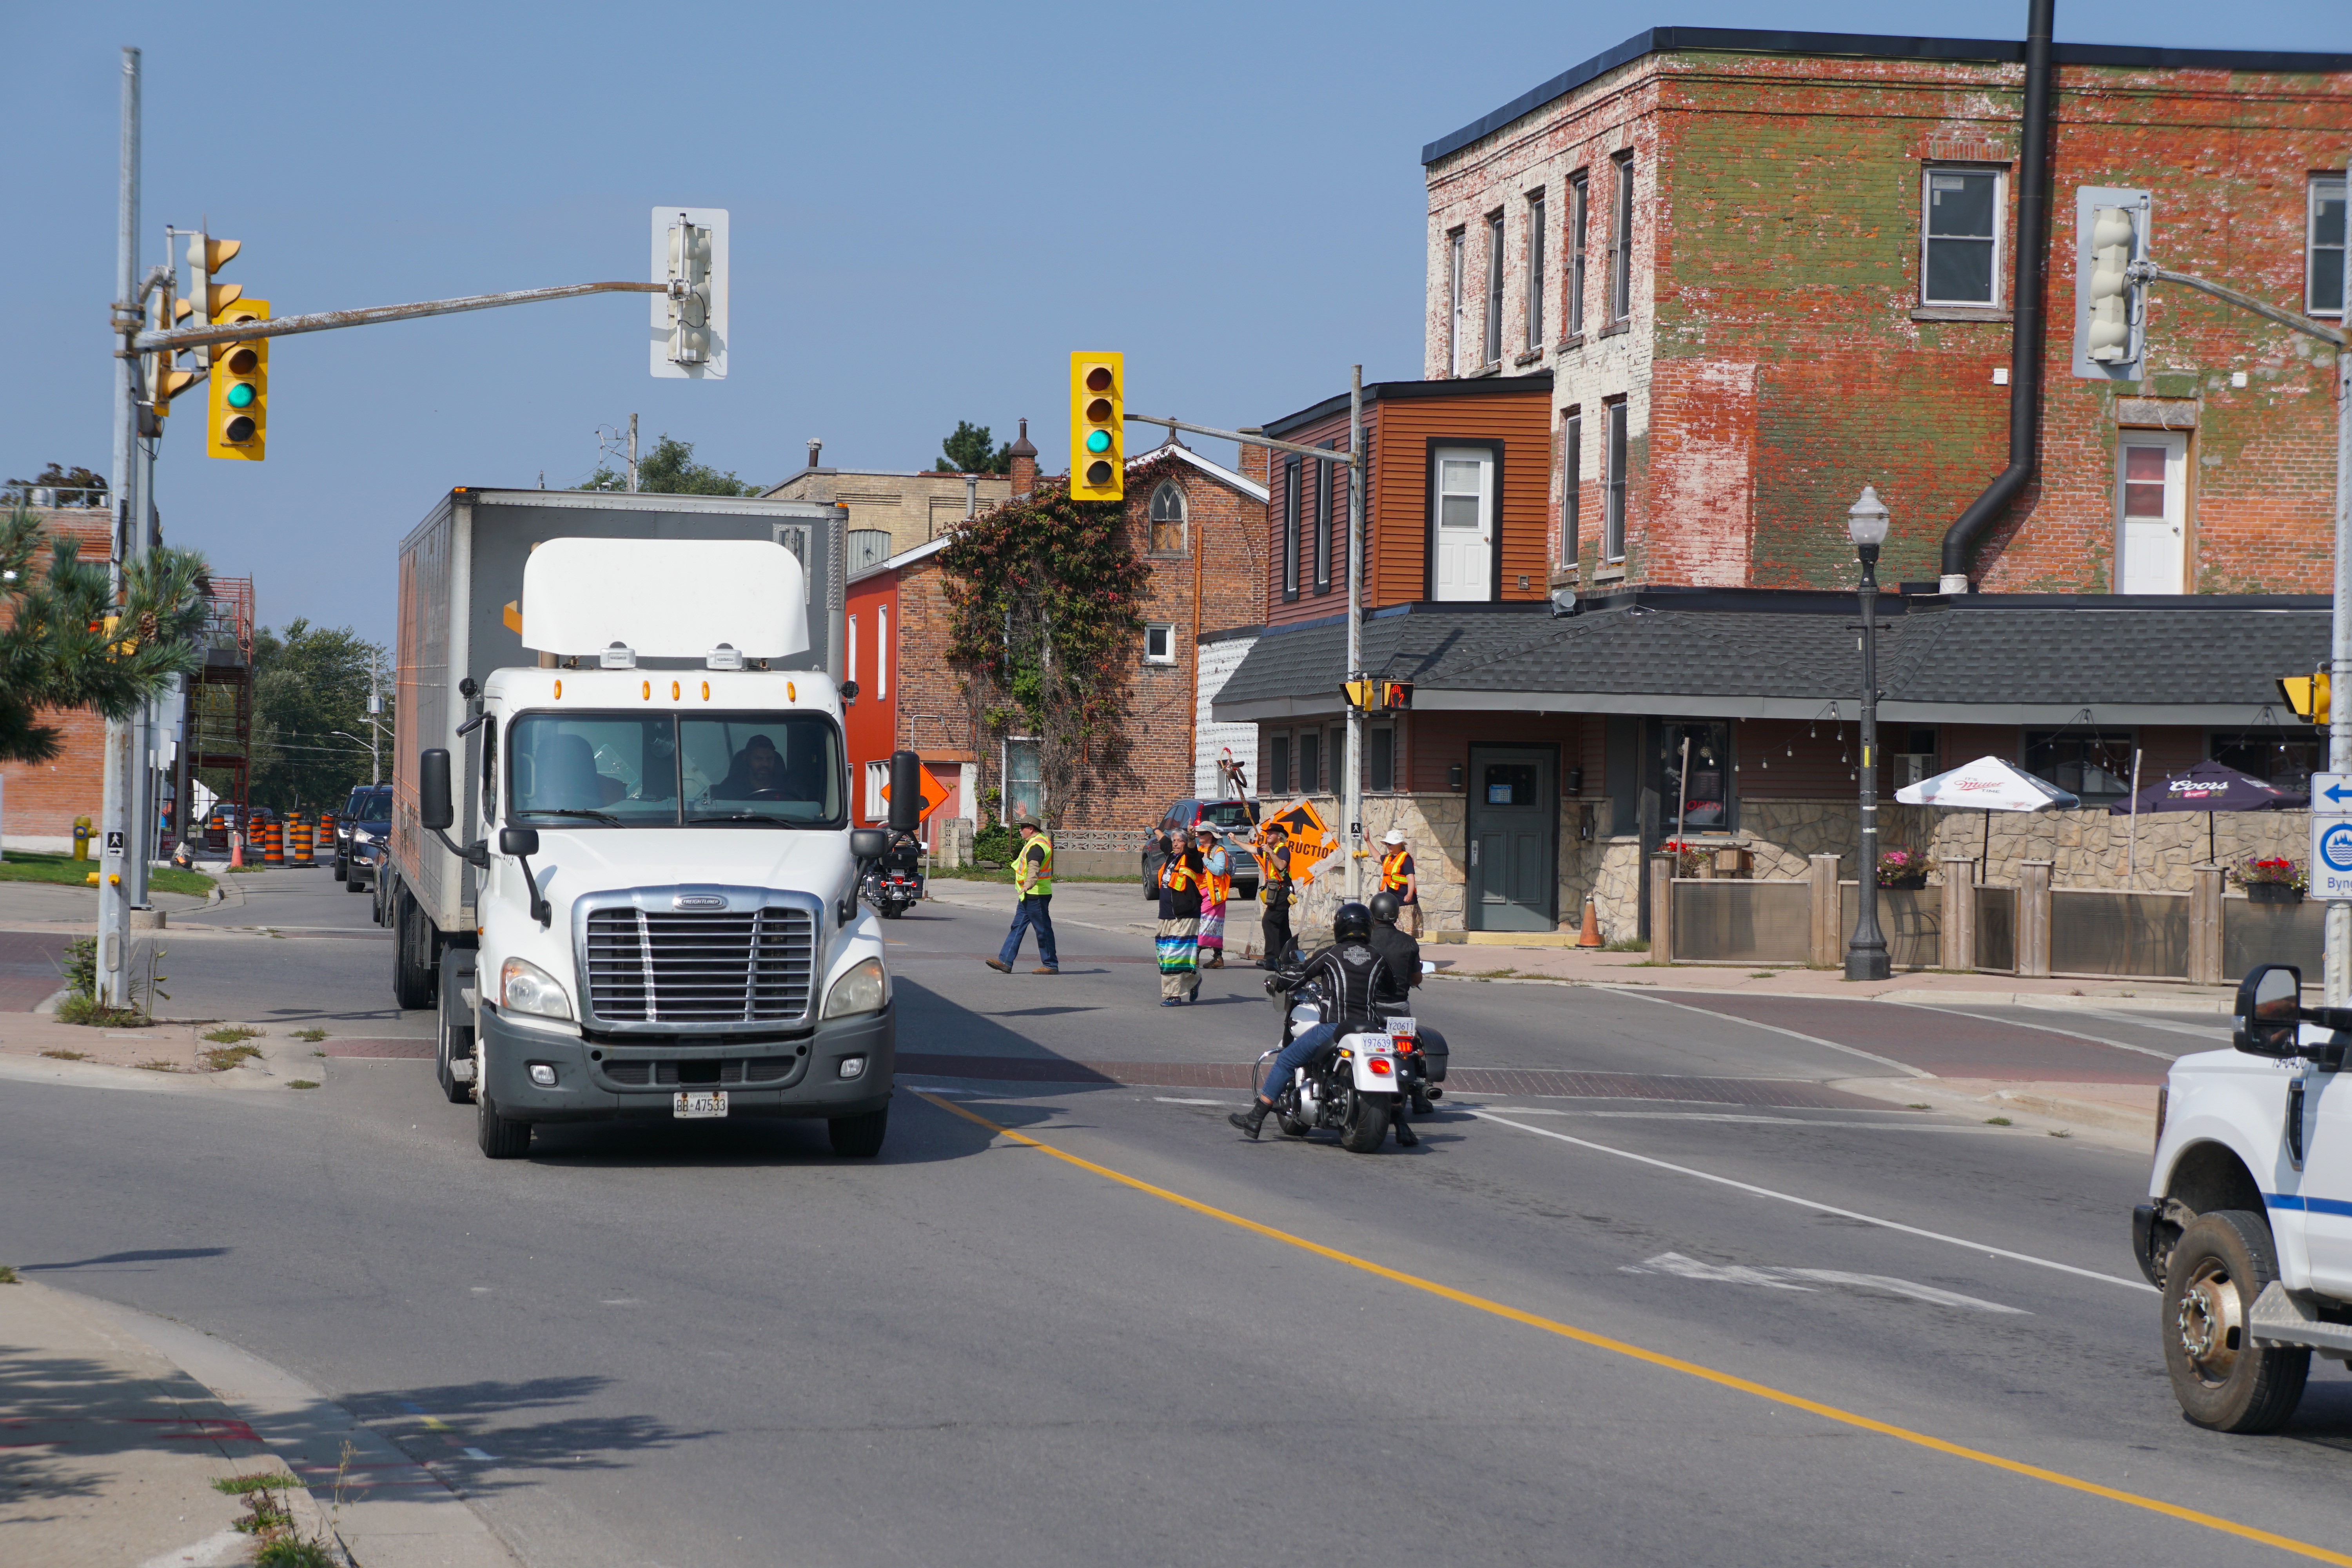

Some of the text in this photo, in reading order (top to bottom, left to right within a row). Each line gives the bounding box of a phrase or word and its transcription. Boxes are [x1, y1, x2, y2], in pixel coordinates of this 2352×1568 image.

[1954, 780, 2005, 789] Miller
[2169, 780, 2229, 791] Coors
[1686, 800, 1723, 811] OPEN
[1389, 1022, 1414, 1031] Y20611
[1363, 1038, 1391, 1047] Y97639
[695, 1099, 725, 1111] 47533
